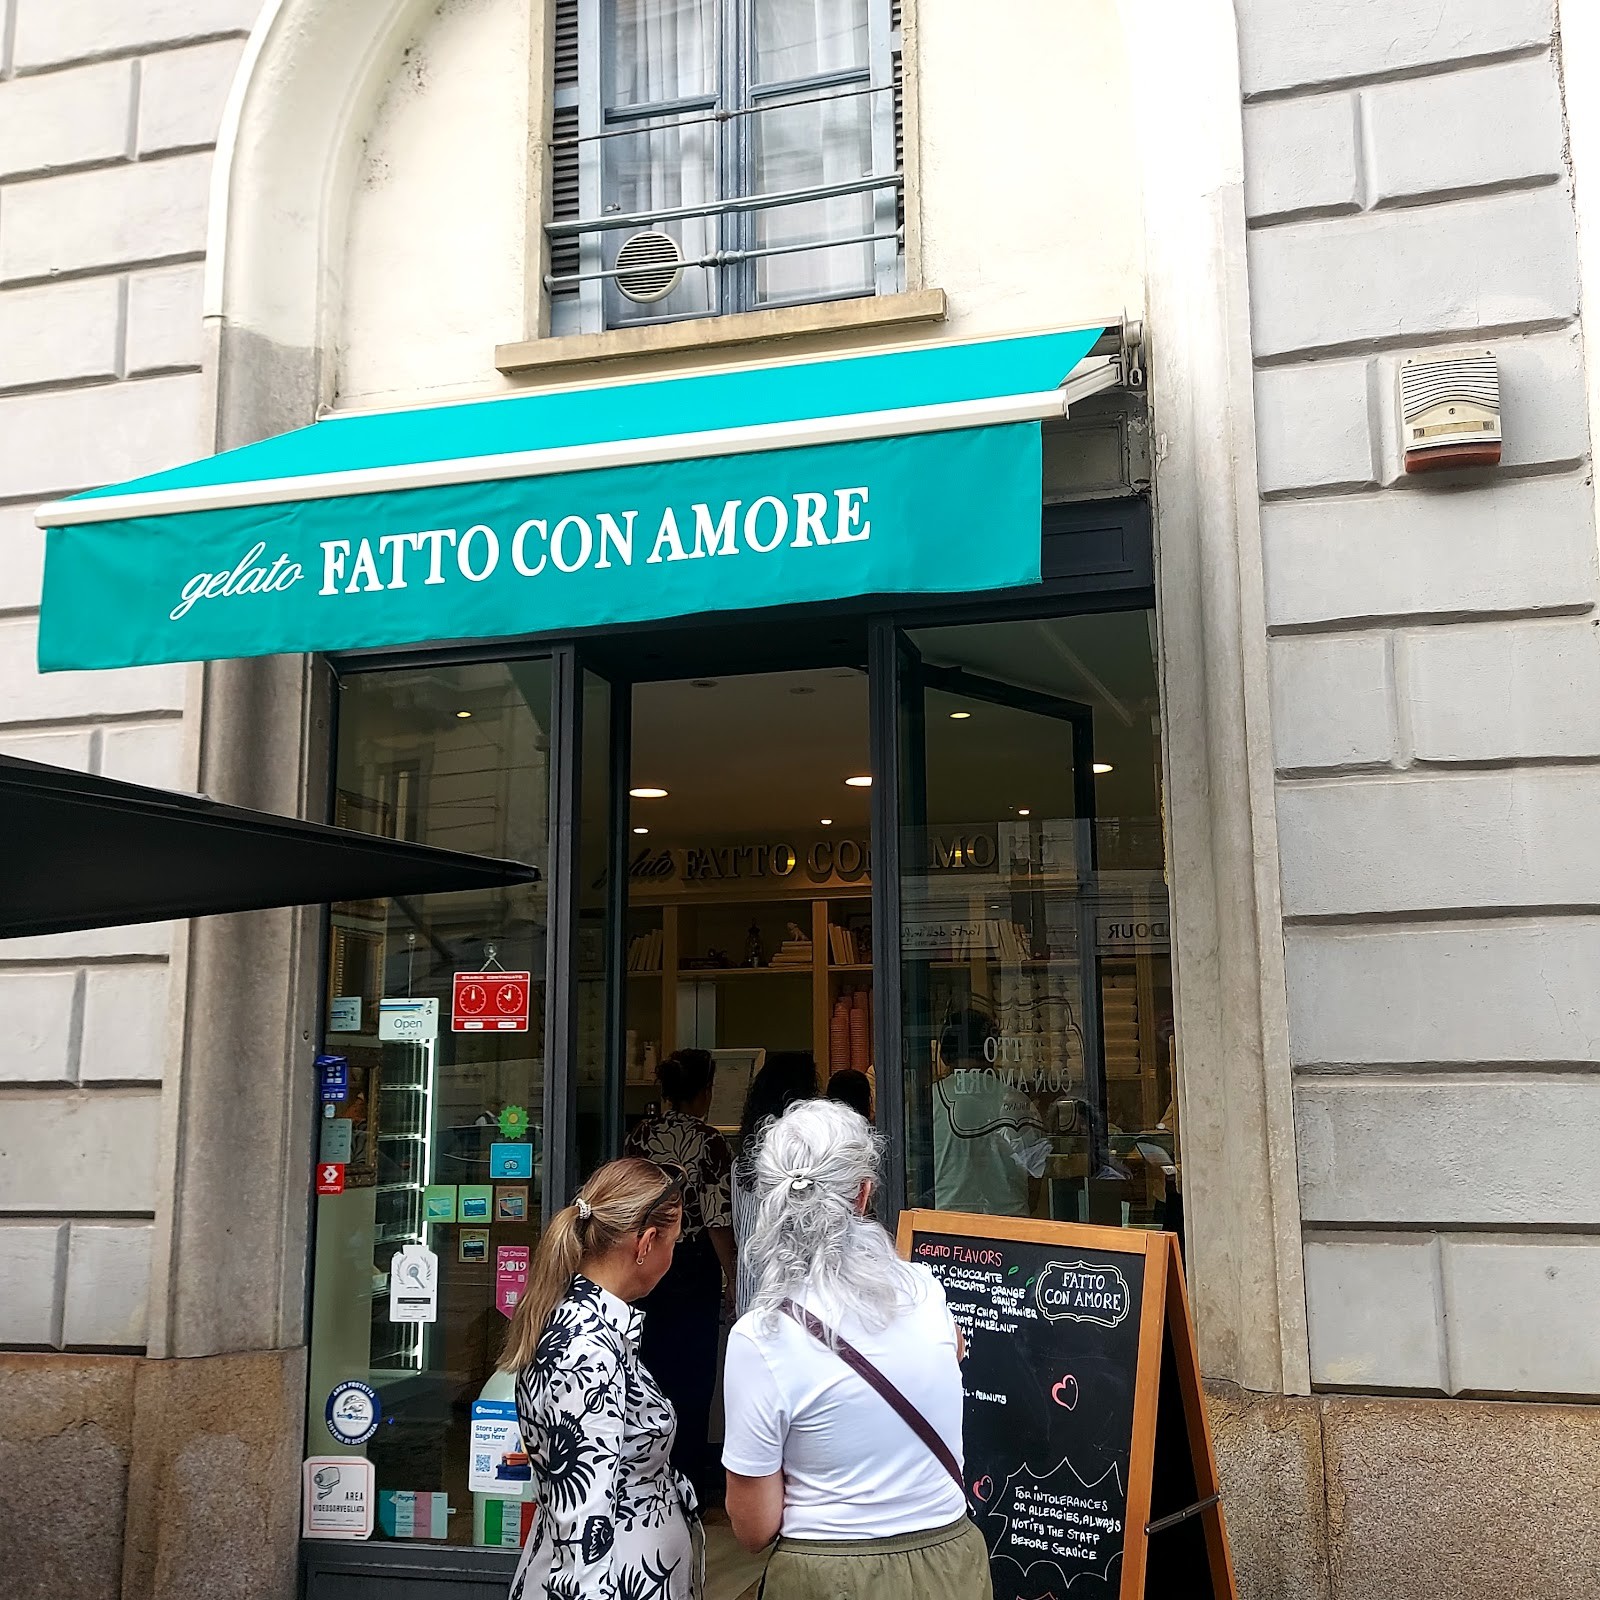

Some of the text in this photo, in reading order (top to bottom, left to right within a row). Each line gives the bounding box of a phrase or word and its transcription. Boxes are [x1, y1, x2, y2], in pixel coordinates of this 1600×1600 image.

[169, 486, 872, 621] gelato FATTO CON AMORE
[681, 842, 796, 881] FATTO
[808, 840, 872, 884] CO
[394, 1019, 422, 1030] Open
[919, 1243, 1003, 1267] GELATO FLAVORS
[949, 1266, 1003, 1284] CHOCOLATE
[1062, 1273, 1106, 1293] FATTO
[1044, 1289, 1121, 1312] CON AMORE
[475, 1433, 490, 1441] bags
[345, 1491, 364, 1501] AREA
[1013, 1502, 1027, 1513] OR
[1010, 1534, 1048, 1550] BEFORE
[1046, 1525, 1064, 1538] THE
[1066, 1529, 1100, 1546] STAFF
